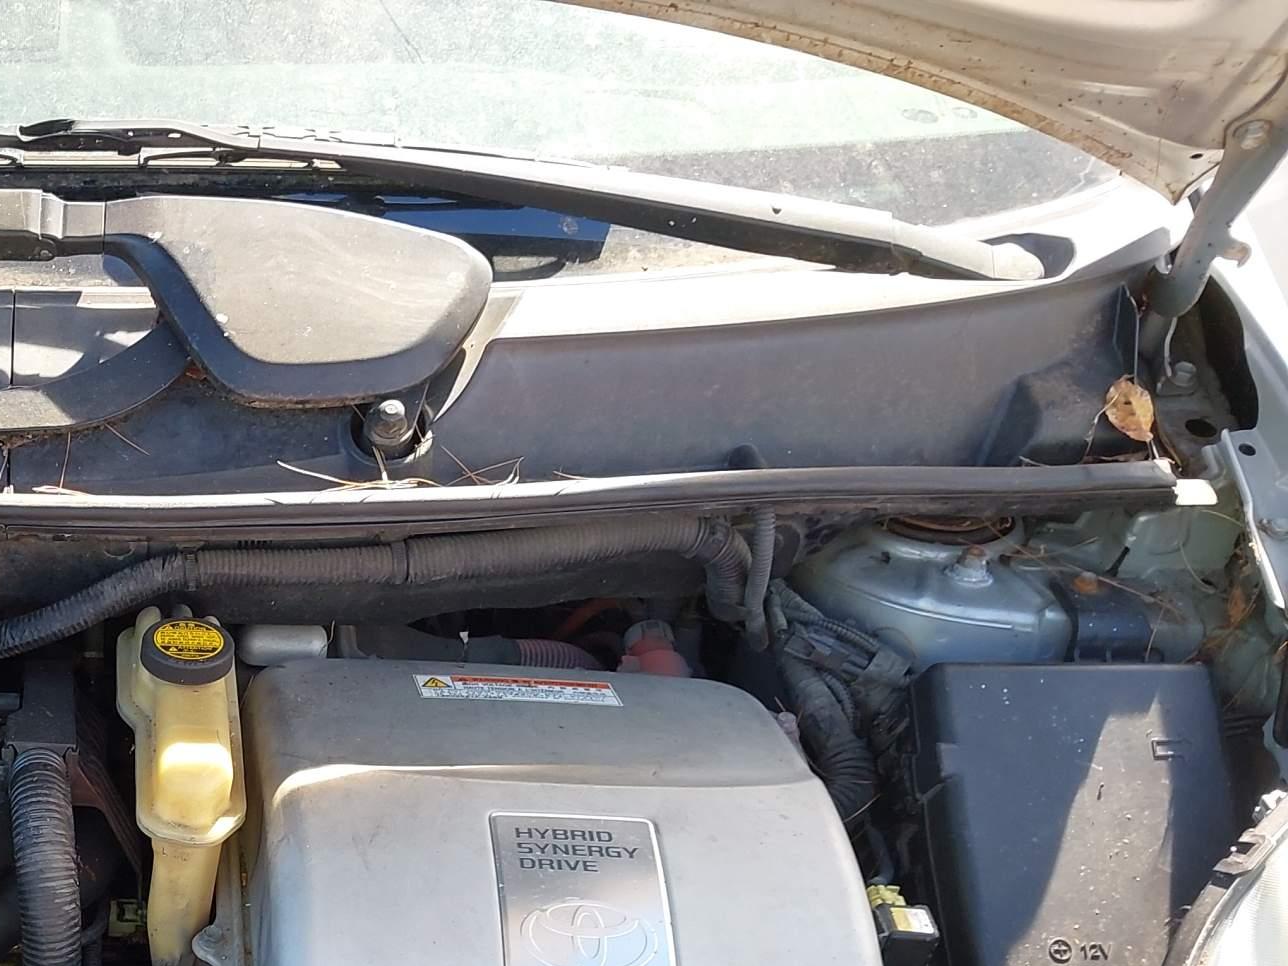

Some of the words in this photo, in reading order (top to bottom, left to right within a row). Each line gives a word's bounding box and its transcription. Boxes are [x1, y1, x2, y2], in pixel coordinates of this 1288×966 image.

[515, 827, 613, 842] HYBRID
[517, 842, 638, 859] SYNERGY
[519, 857, 599, 872] DRIVE
[1080, 943, 1111, 961] 12V
